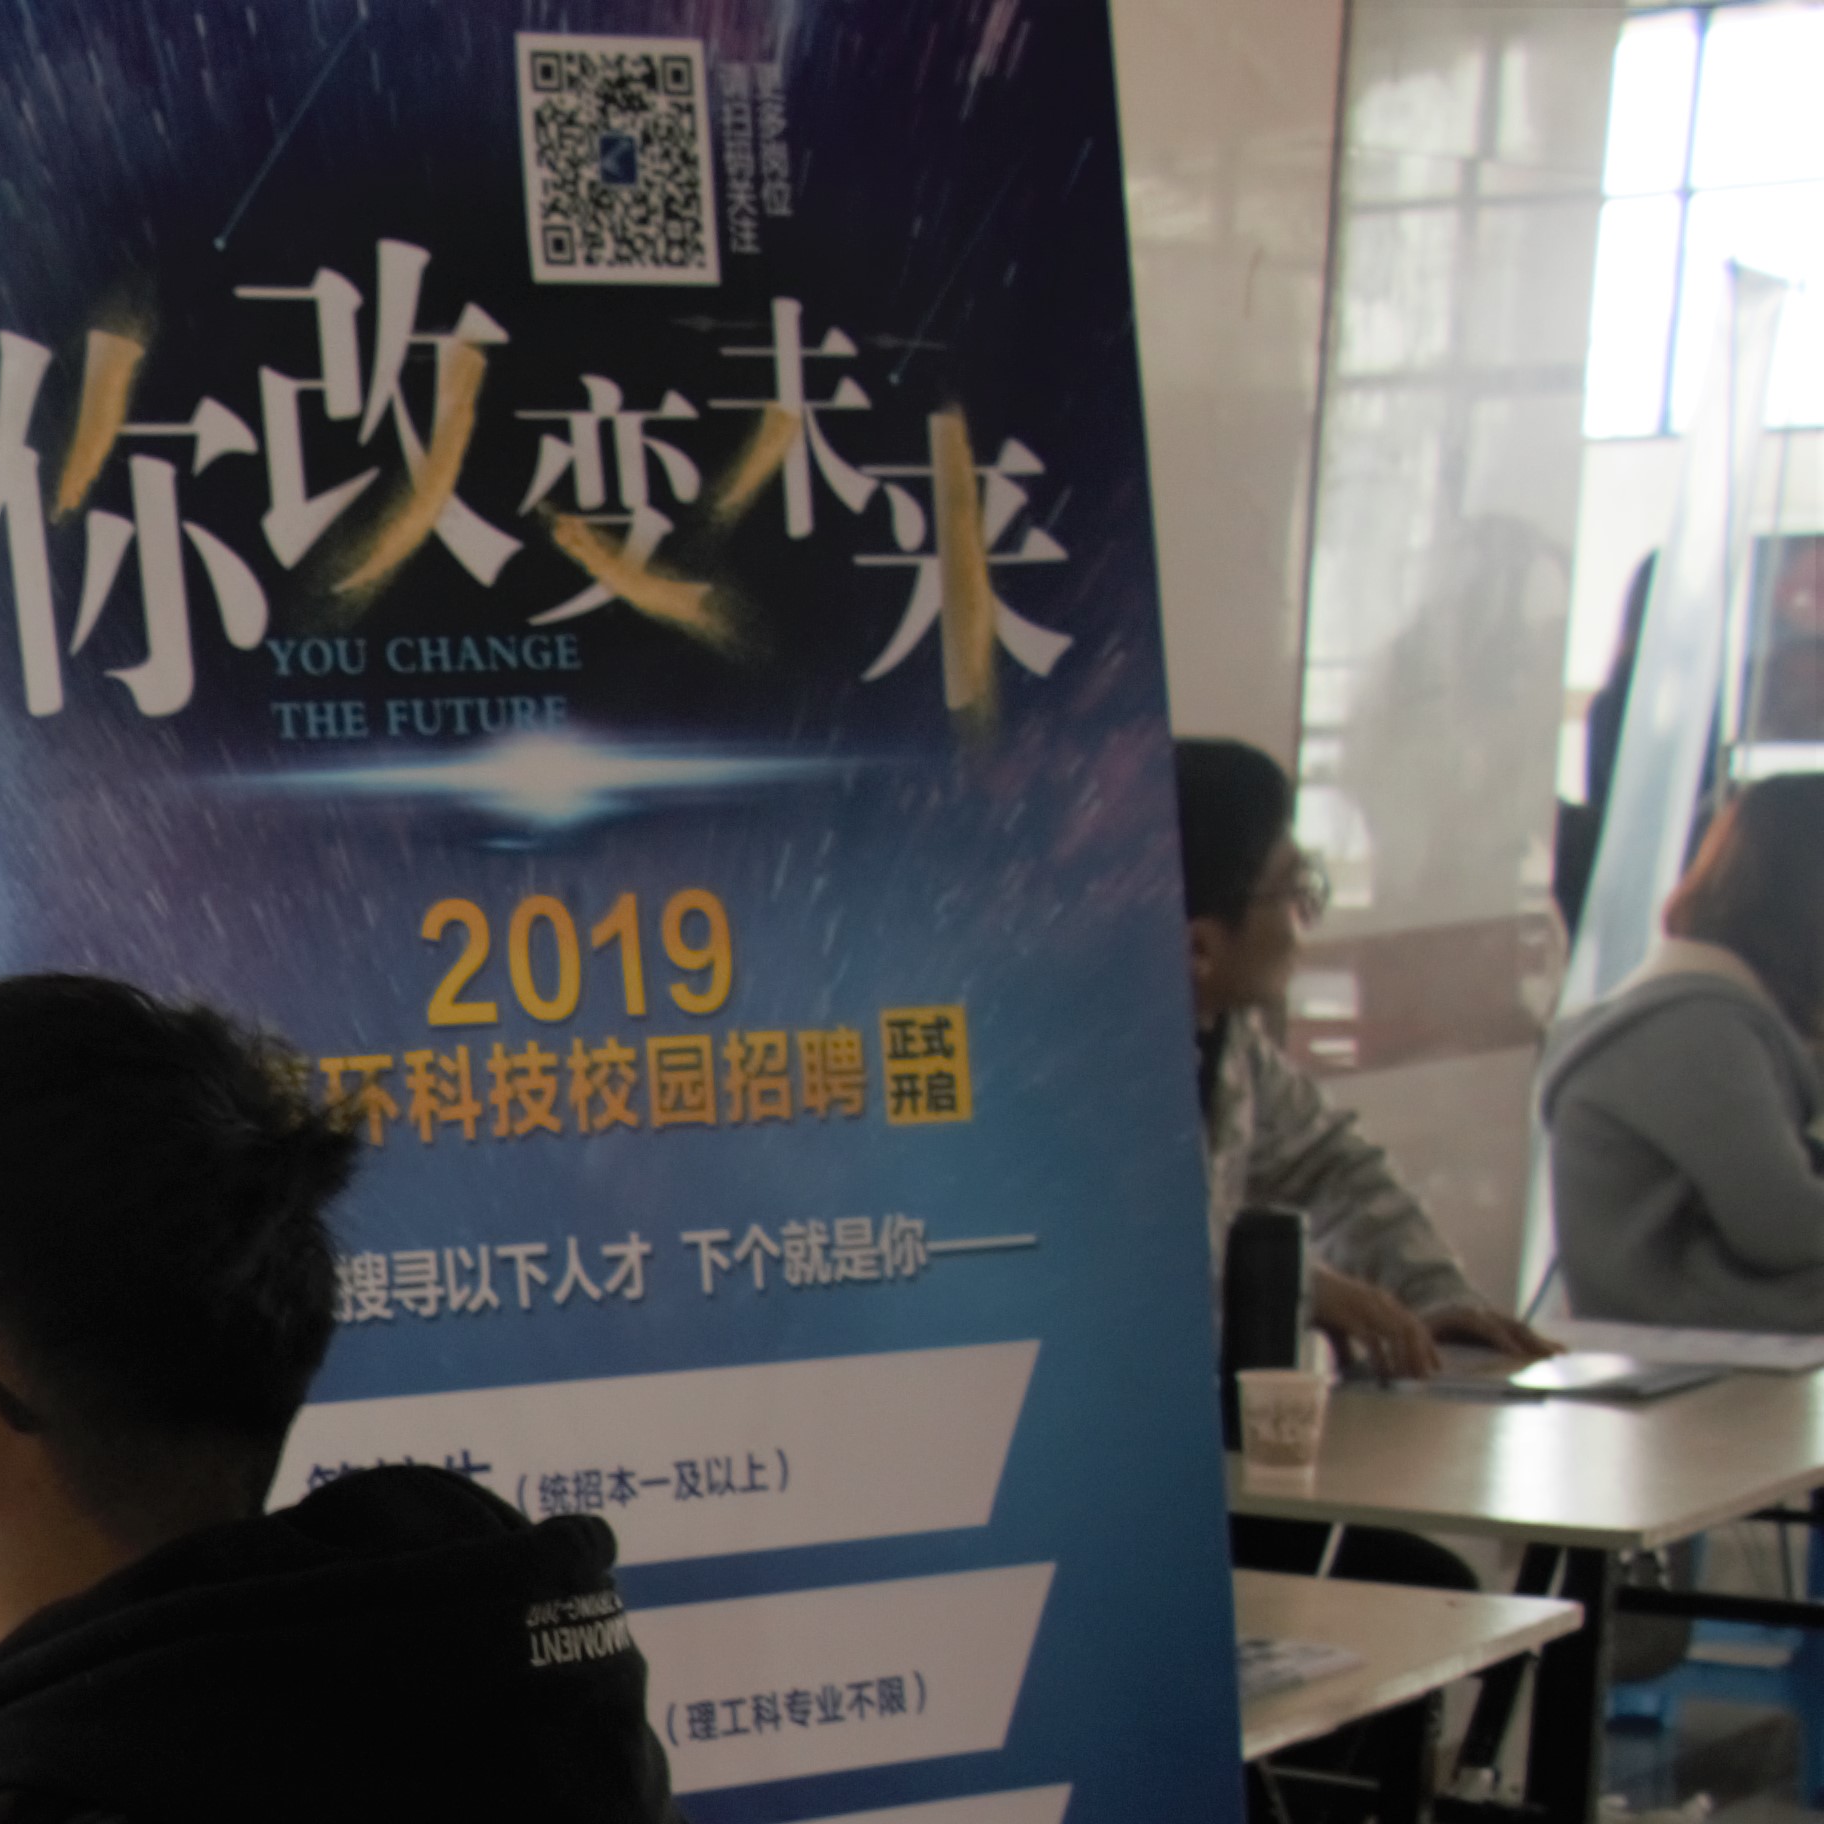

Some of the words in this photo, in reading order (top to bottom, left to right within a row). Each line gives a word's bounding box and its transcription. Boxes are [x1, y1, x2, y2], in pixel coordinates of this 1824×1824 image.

[265, 637, 368, 677] YOU
[386, 633, 582, 673] CHANGE
[270, 698, 369, 738] THE
[386, 695, 568, 736] FUTURE
[419, 888, 733, 1028] 2019
[885, 1016, 954, 1062] 正式
[282, 1028, 869, 1148] 环科技校园招聘
[888, 1071, 958, 1117] 开启
[335, 1232, 652, 1324] 搜寻以下人才
